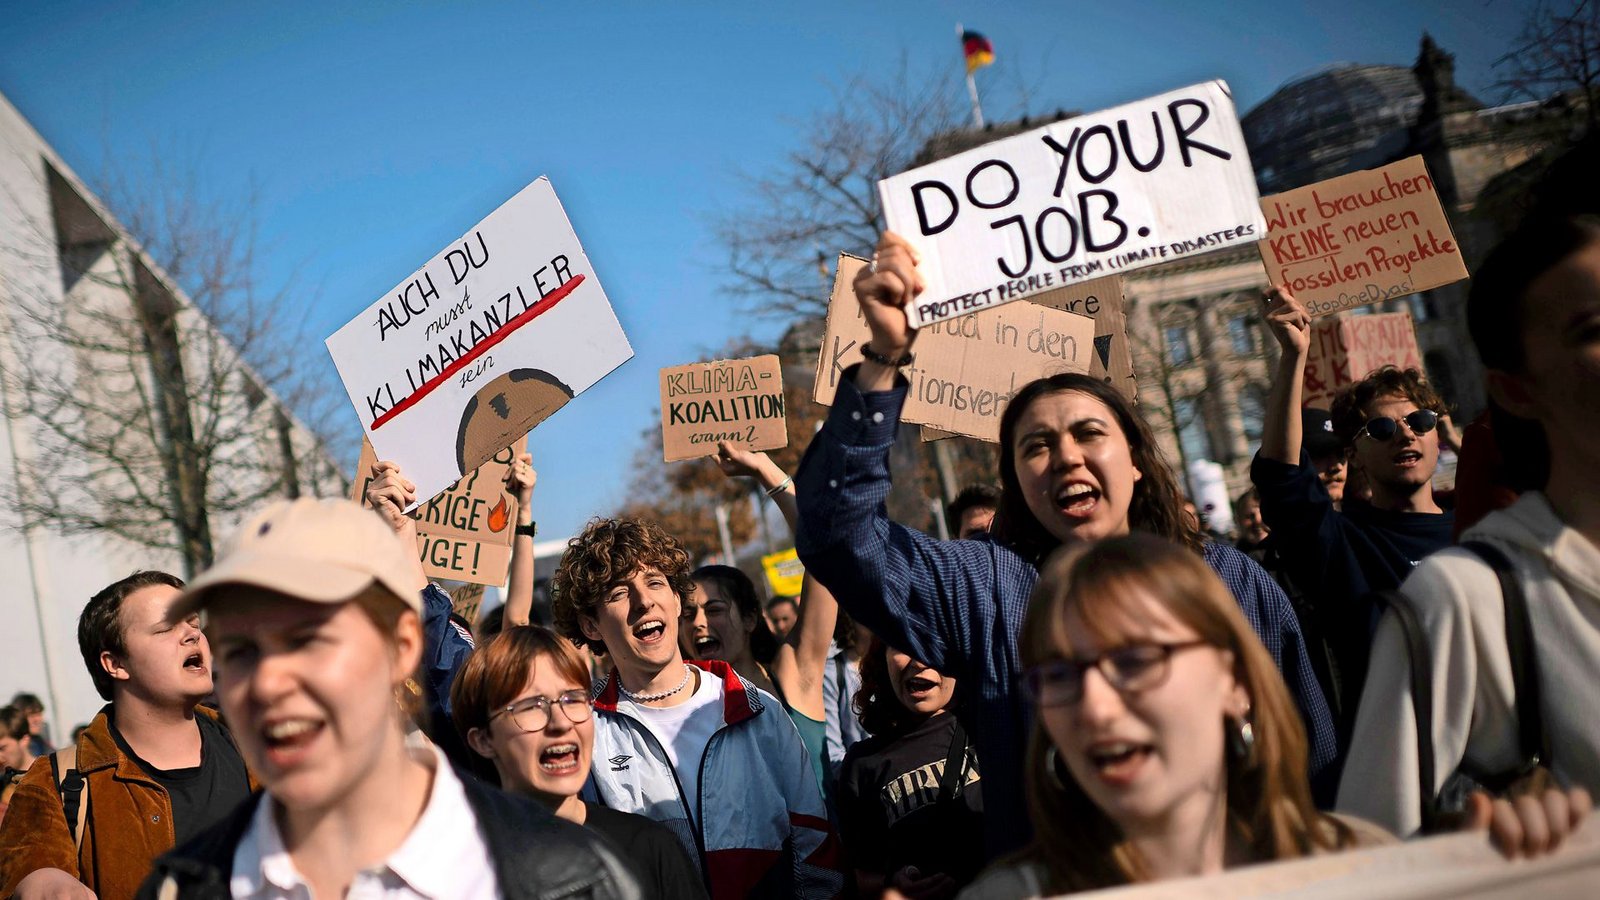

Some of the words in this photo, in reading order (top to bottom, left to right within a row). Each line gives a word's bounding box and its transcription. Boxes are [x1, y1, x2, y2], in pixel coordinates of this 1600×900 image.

[911, 158, 1020, 236] DO
[1041, 98, 1232, 197] YOUR
[990, 188, 1151, 278] JOB.
[1267, 202, 1307, 233] Wir
[1312, 171, 1433, 219] brauchen
[1269, 222, 1342, 265] KEINE
[1343, 209, 1420, 243] neuen
[1281, 256, 1372, 298] fossilen
[1366, 230, 1457, 274] Projekte
[377, 271, 440, 342] AUCH
[444, 231, 490, 286] DU
[918, 287, 994, 322] PROTECT
[997, 270, 1054, 300] PEOPLE
[1060, 259, 1103, 284] FROM
[1108, 245, 1168, 269] CLIMATE
[1171, 223, 1256, 256] DISASTERS
[366, 254, 575, 422] KLIMAKANZLER
[425, 285, 473, 341] musst
[996, 314, 1019, 348] in
[1027, 310, 1077, 362] den
[459, 354, 495, 389] sein
[667, 366, 772, 397] KLIMA-
[669, 392, 785, 425] KOALITION
